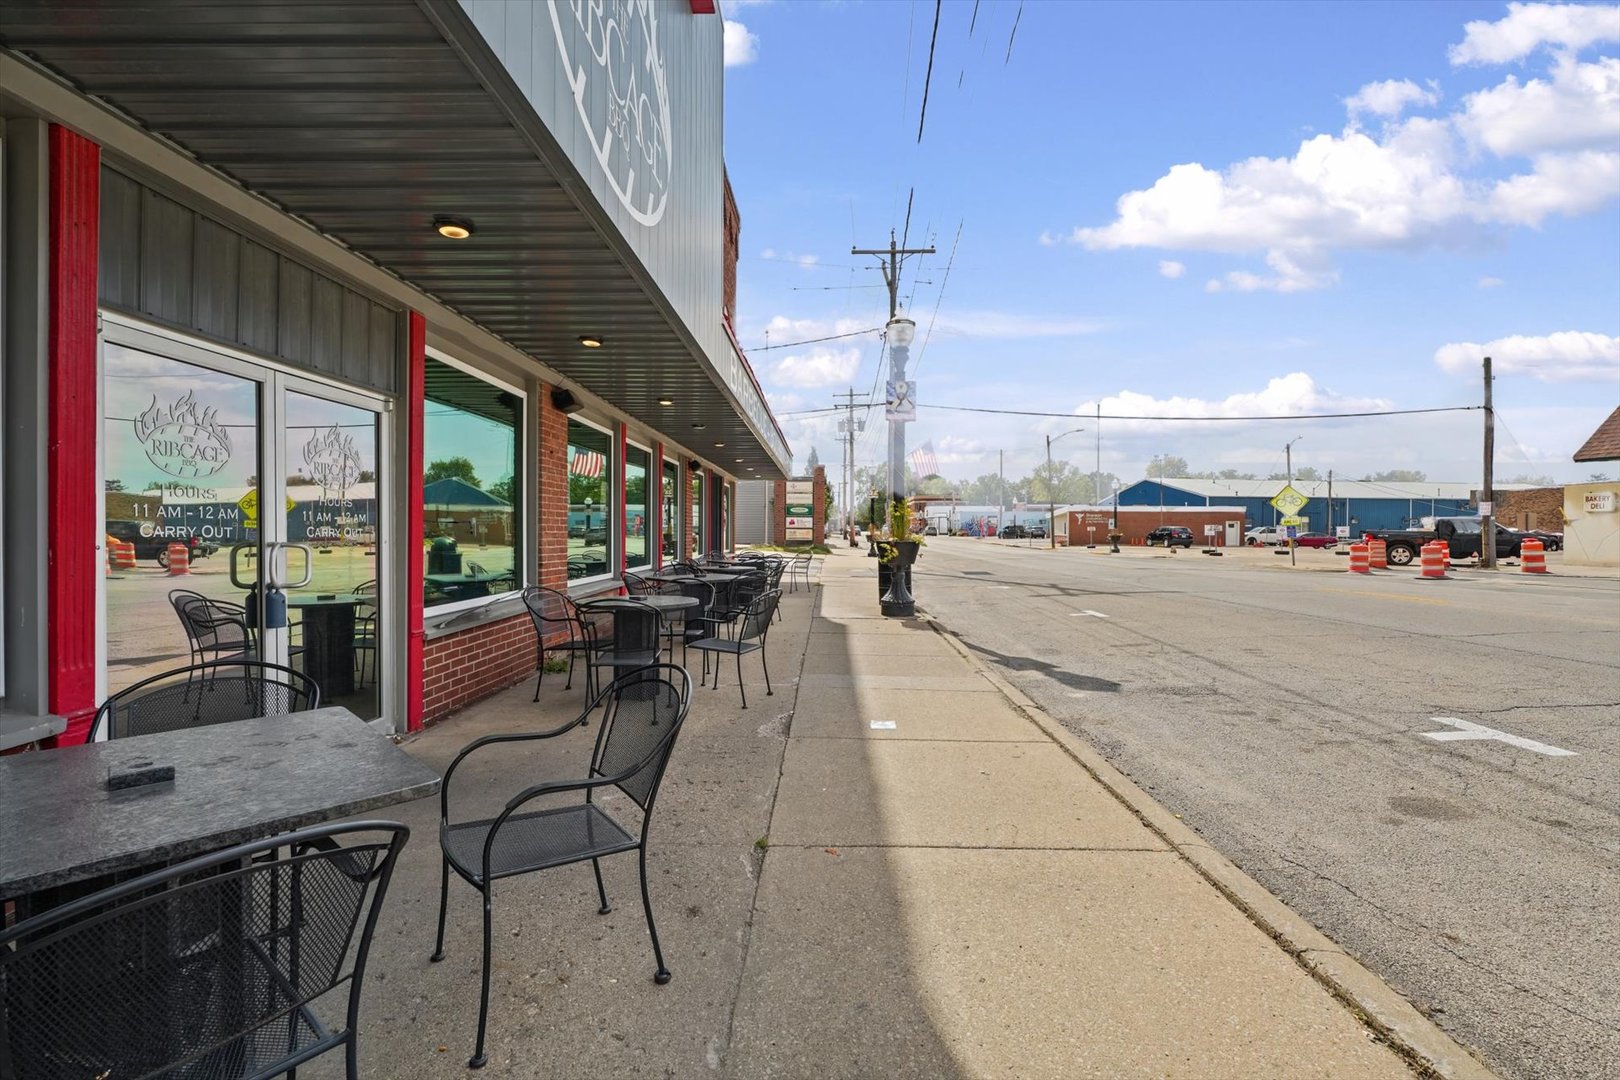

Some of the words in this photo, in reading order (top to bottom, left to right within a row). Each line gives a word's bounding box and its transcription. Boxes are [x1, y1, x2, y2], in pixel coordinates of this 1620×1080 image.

[569, 0, 663, 190] BCAGE
[608, 91, 631, 163] BBQ
[151, 439, 223, 463] RIBCAGE
[160, 483, 217, 500] HOURS
[1585, 495, 1611, 503] BAKERY
[318, 495, 353, 508] HOURS
[1590, 502, 1605, 510] DELI
[133, 503, 149, 518] 11
[156, 506, 181, 519] AM
[198, 506, 214, 519] 12
[217, 508, 239, 520] AM
[302, 510, 313, 522] 11
[316, 512, 332, 523] AM
[353, 514, 367, 523] AM
[139, 523, 197, 538] CARRY
[201, 525, 233, 538] OUT
[306, 526, 341, 538] CARRY
[343, 527, 364, 538] OUT
